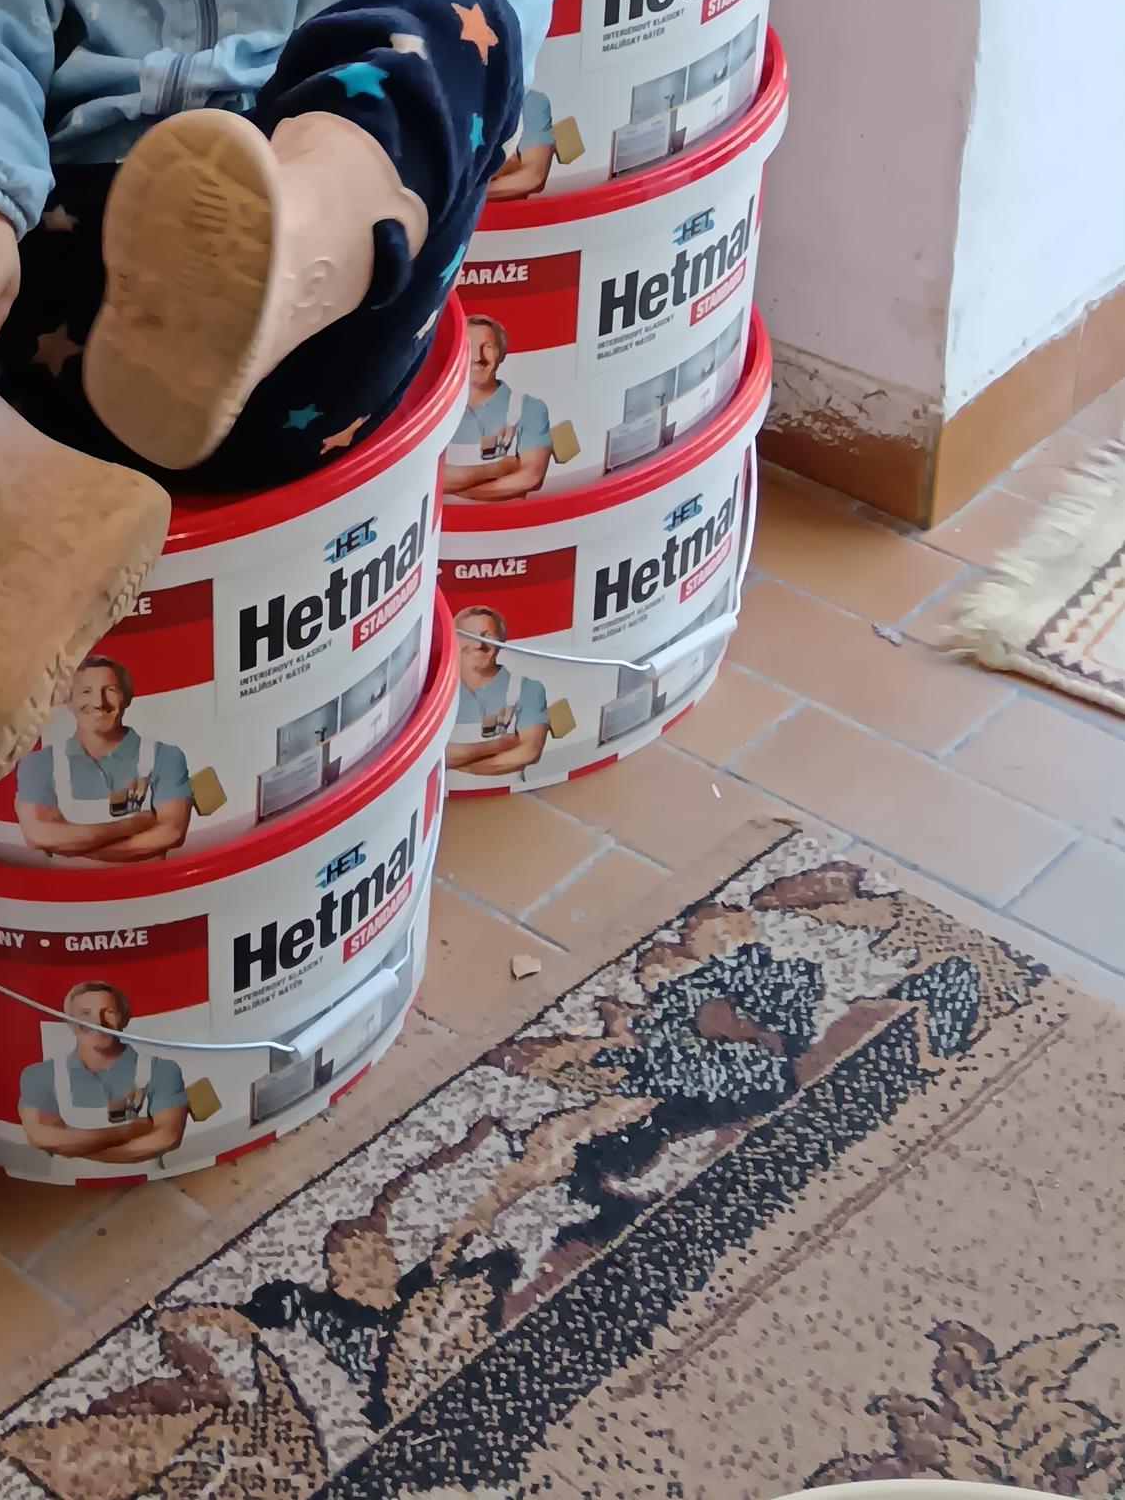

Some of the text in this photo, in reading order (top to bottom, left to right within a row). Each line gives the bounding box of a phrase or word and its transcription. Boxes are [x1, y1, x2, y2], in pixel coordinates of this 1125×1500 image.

[682, 207, 713, 240] HET
[598, 194, 754, 336] Hetmal
[672, 493, 703, 526] HET
[335, 516, 377, 558] HET
[593, 476, 738, 621] Hetmal
[239, 494, 429, 672] Hetmal
[455, 558, 527, 579] GARÁŽE
[327, 841, 366, 884] HET
[234, 808, 418, 993] Hetmal
[65, 928, 149, 951] GARÁŽE
